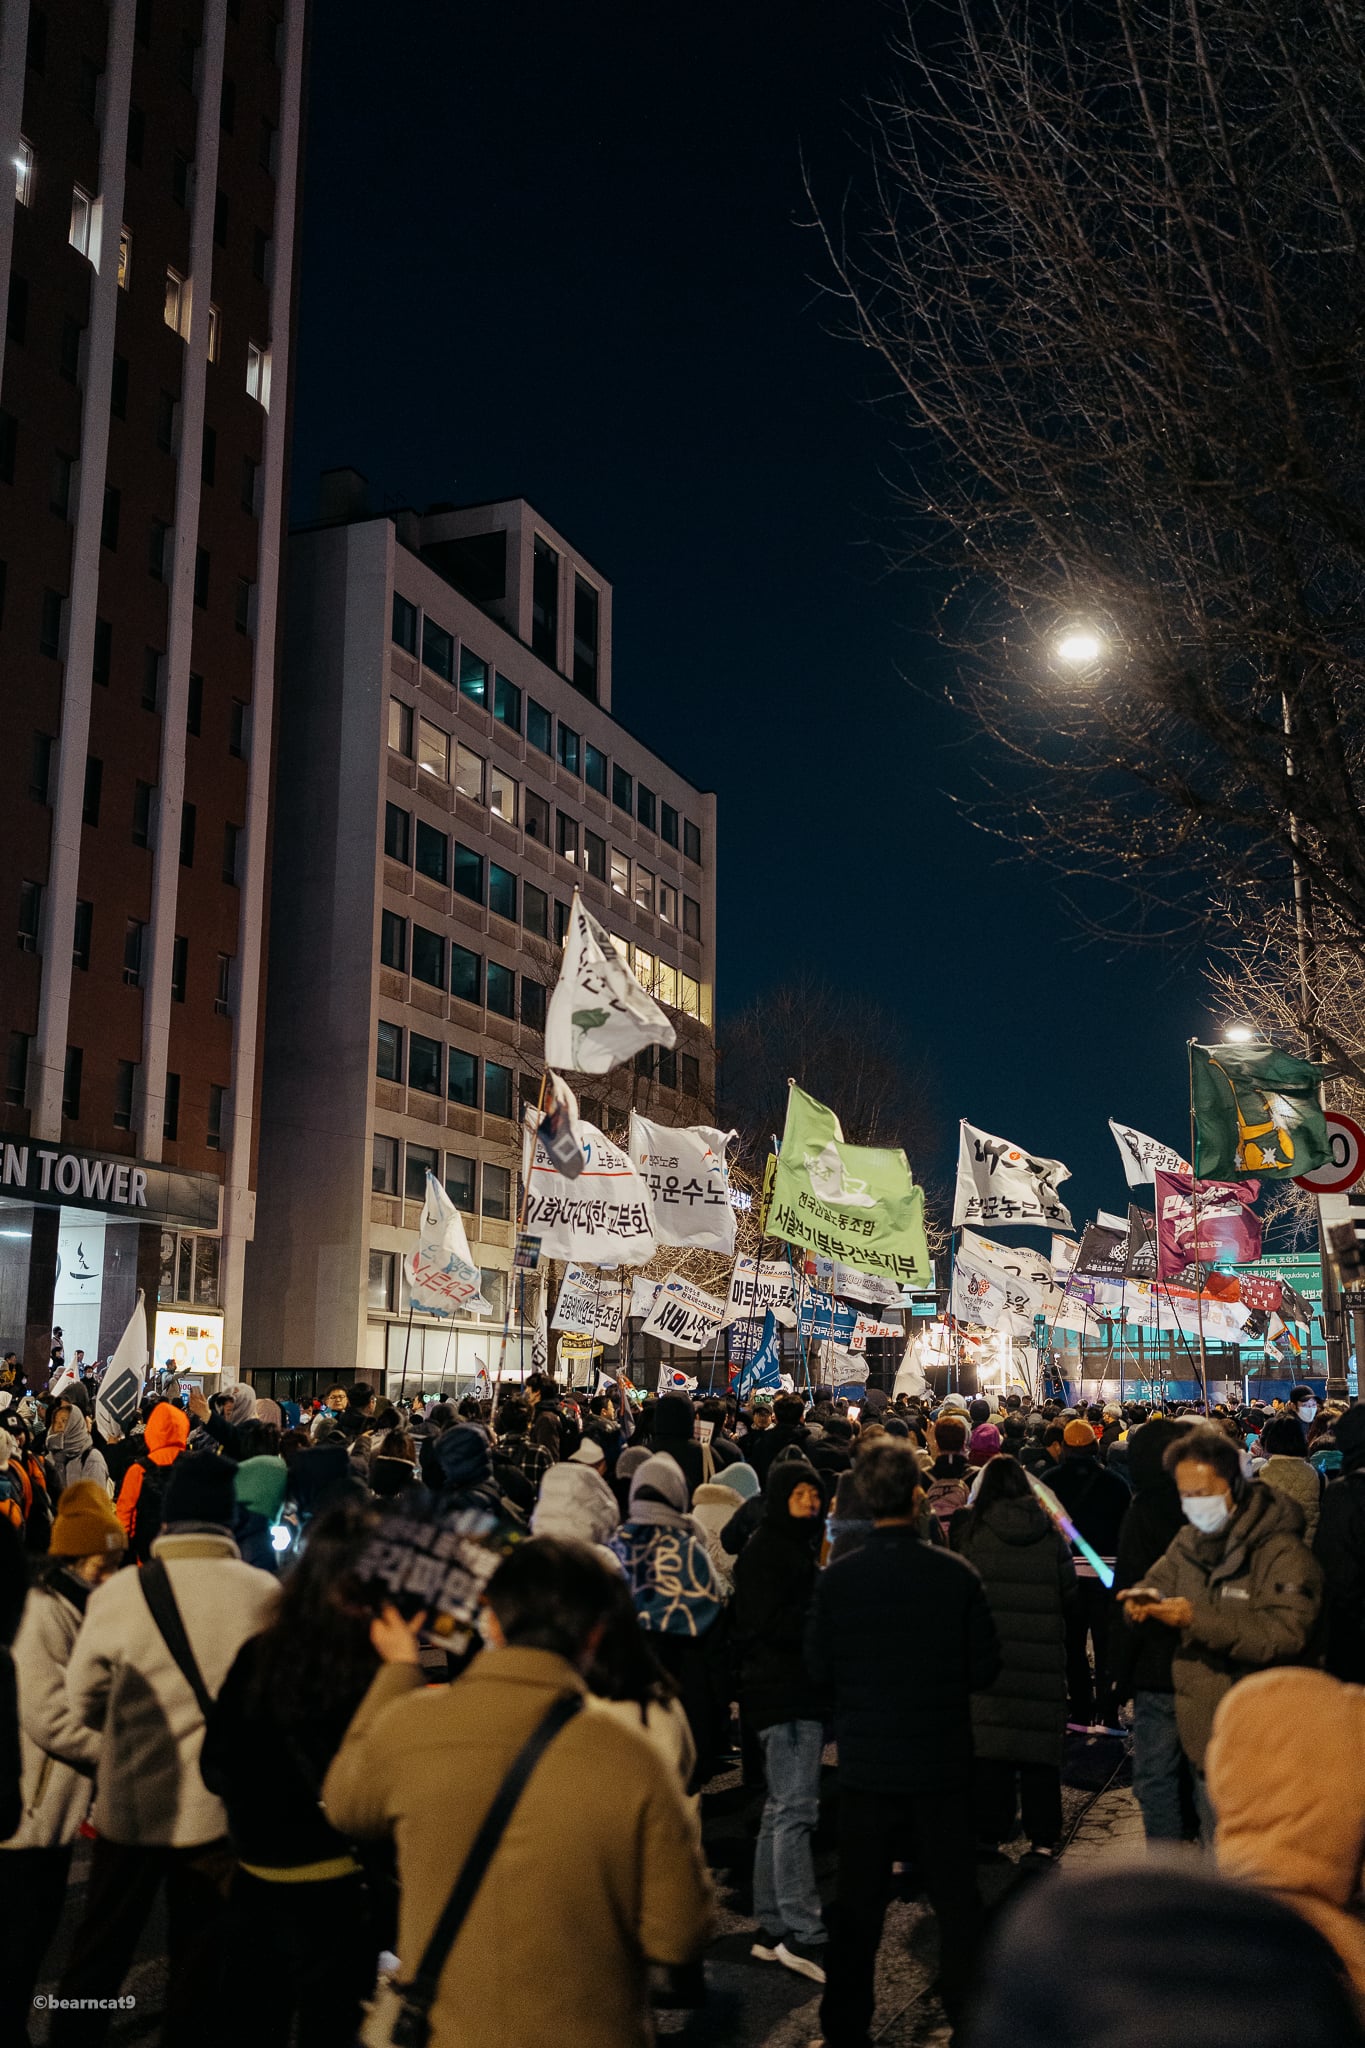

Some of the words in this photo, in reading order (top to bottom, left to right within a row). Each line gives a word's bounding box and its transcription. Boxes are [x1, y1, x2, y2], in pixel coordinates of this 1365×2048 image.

[0, 1142, 29, 1187] N
[36, 1150, 148, 1206] TOWER
[775, 1204, 919, 1279] 서울경기북부건설지부
